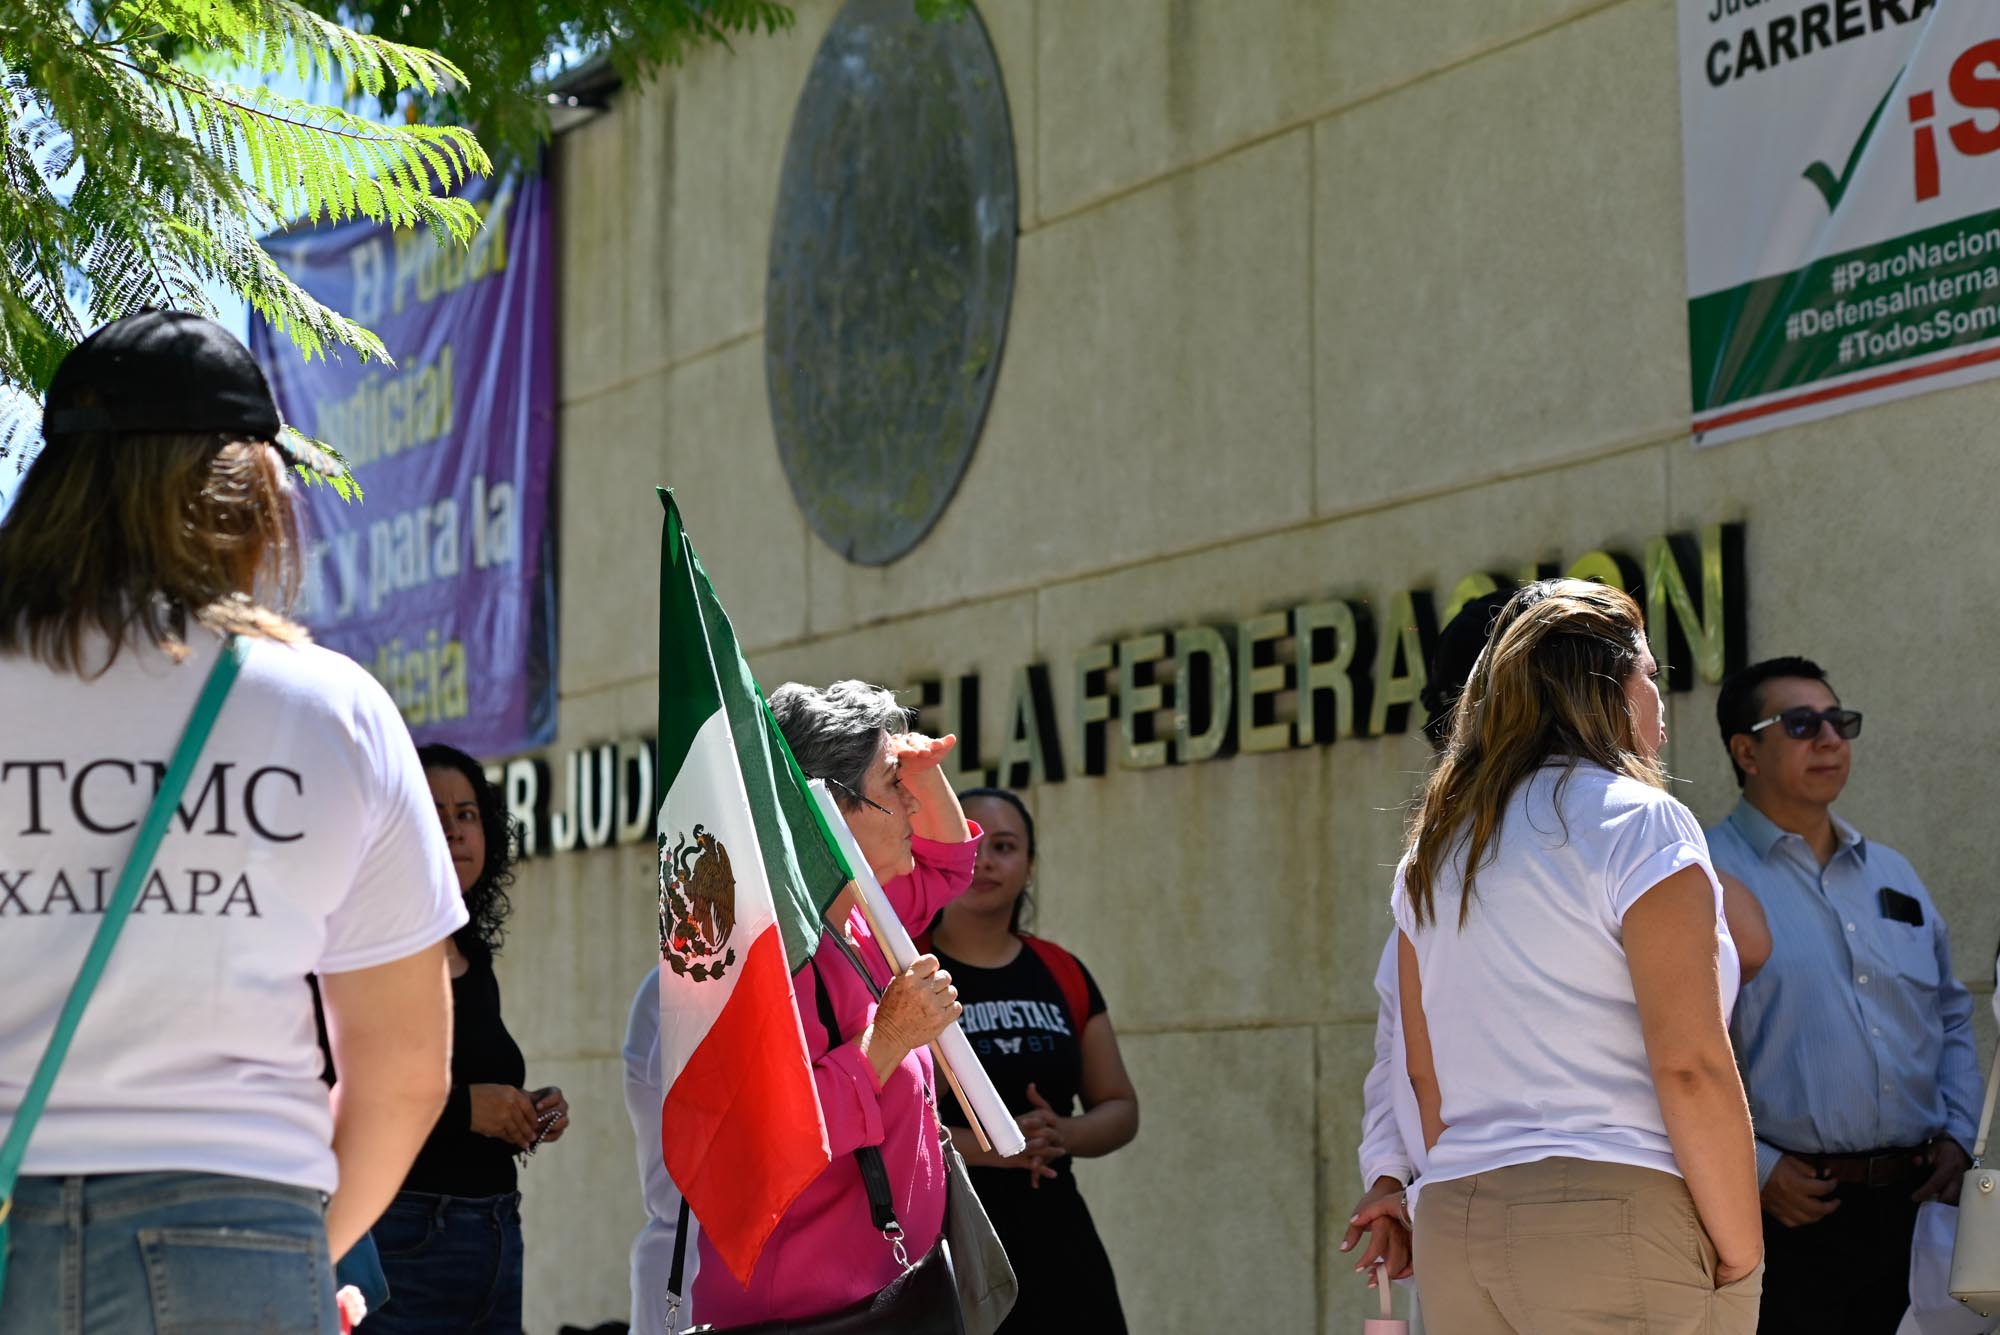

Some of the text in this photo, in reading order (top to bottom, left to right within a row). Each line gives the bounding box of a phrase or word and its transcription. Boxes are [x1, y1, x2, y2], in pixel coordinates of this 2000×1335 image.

[1785, 265, 2000, 342] #DefensaInterna
[1837, 303, 2000, 364] #TodosSom
[367, 498, 460, 612] para
[472, 474, 514, 569] la
[552, 740, 655, 854] JUD
[947, 664, 1048, 792] LA
[1073, 523, 1726, 776] FEDERAN
[1, 759, 305, 842] TCMC
[0, 868, 262, 918] XALAPA
[958, 1000, 1072, 1036] ROPOSTALE
